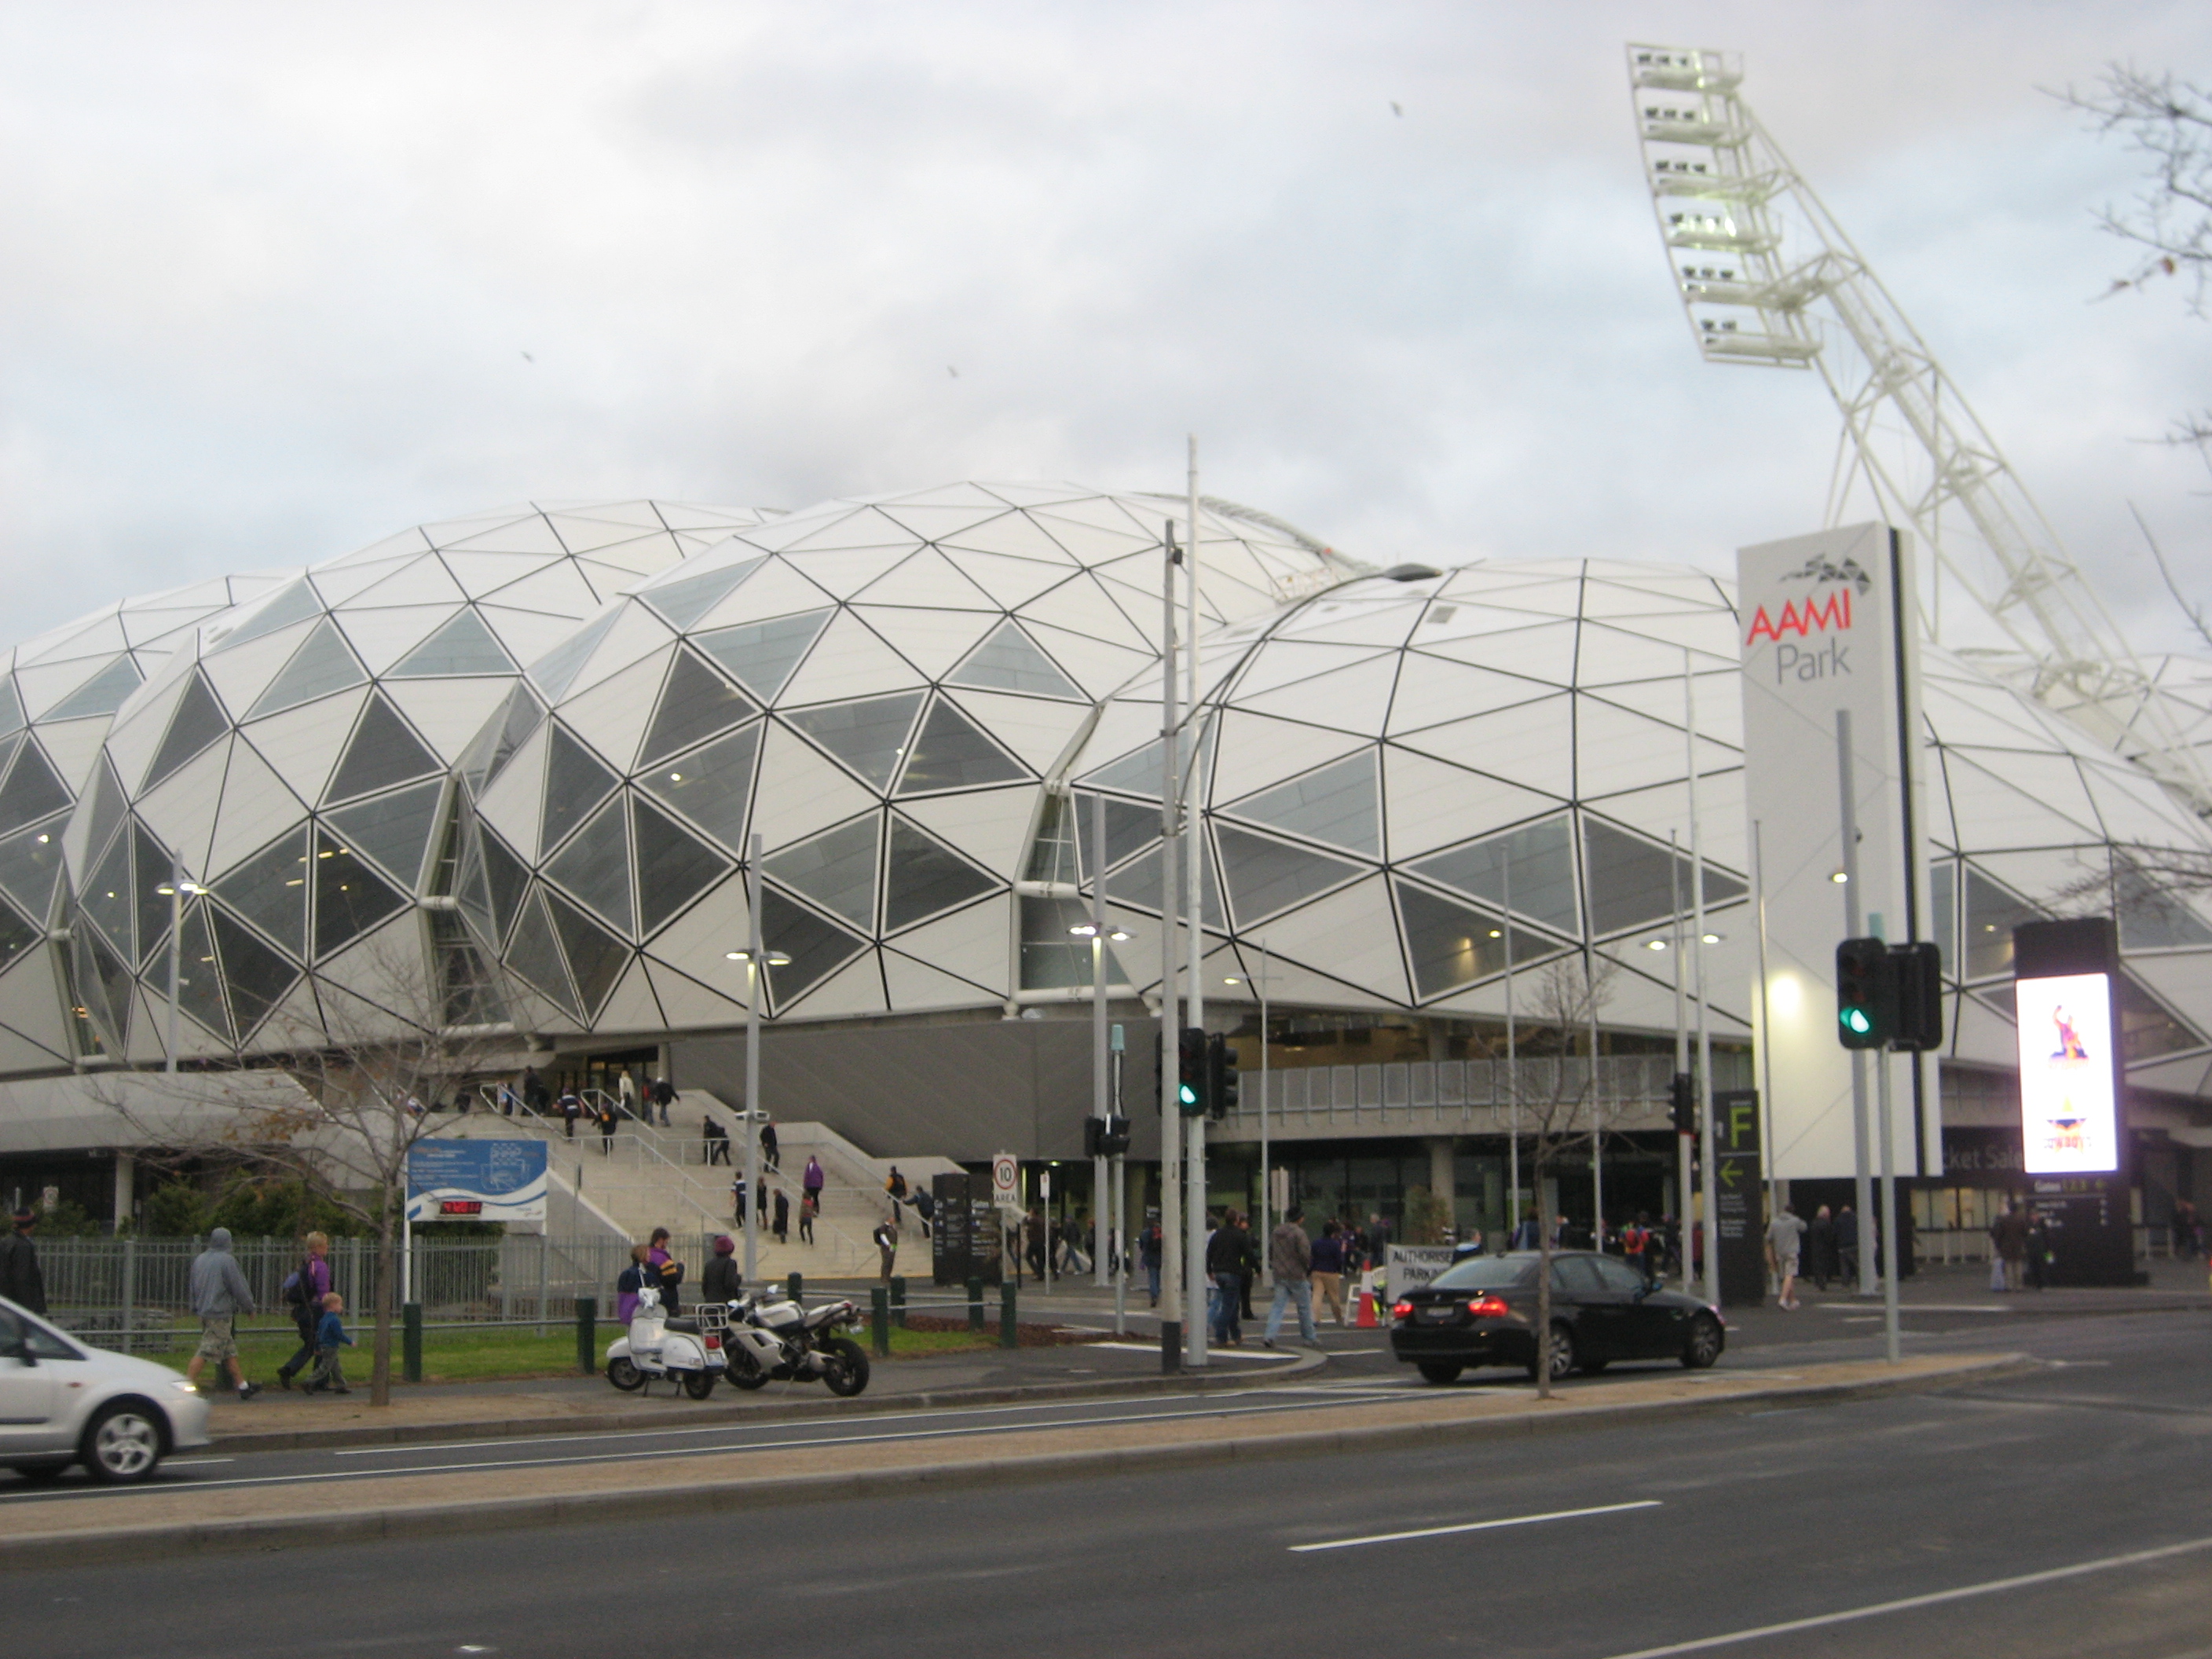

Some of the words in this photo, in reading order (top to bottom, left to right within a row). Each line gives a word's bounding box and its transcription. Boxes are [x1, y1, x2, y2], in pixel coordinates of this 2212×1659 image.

[1745, 588, 1852, 646] AAMI
[1776, 636, 1852, 685] Park
[1730, 1106, 1752, 1148] F
[999, 1167, 1012, 1181] 10
[994, 1194, 1016, 1203] AREA
